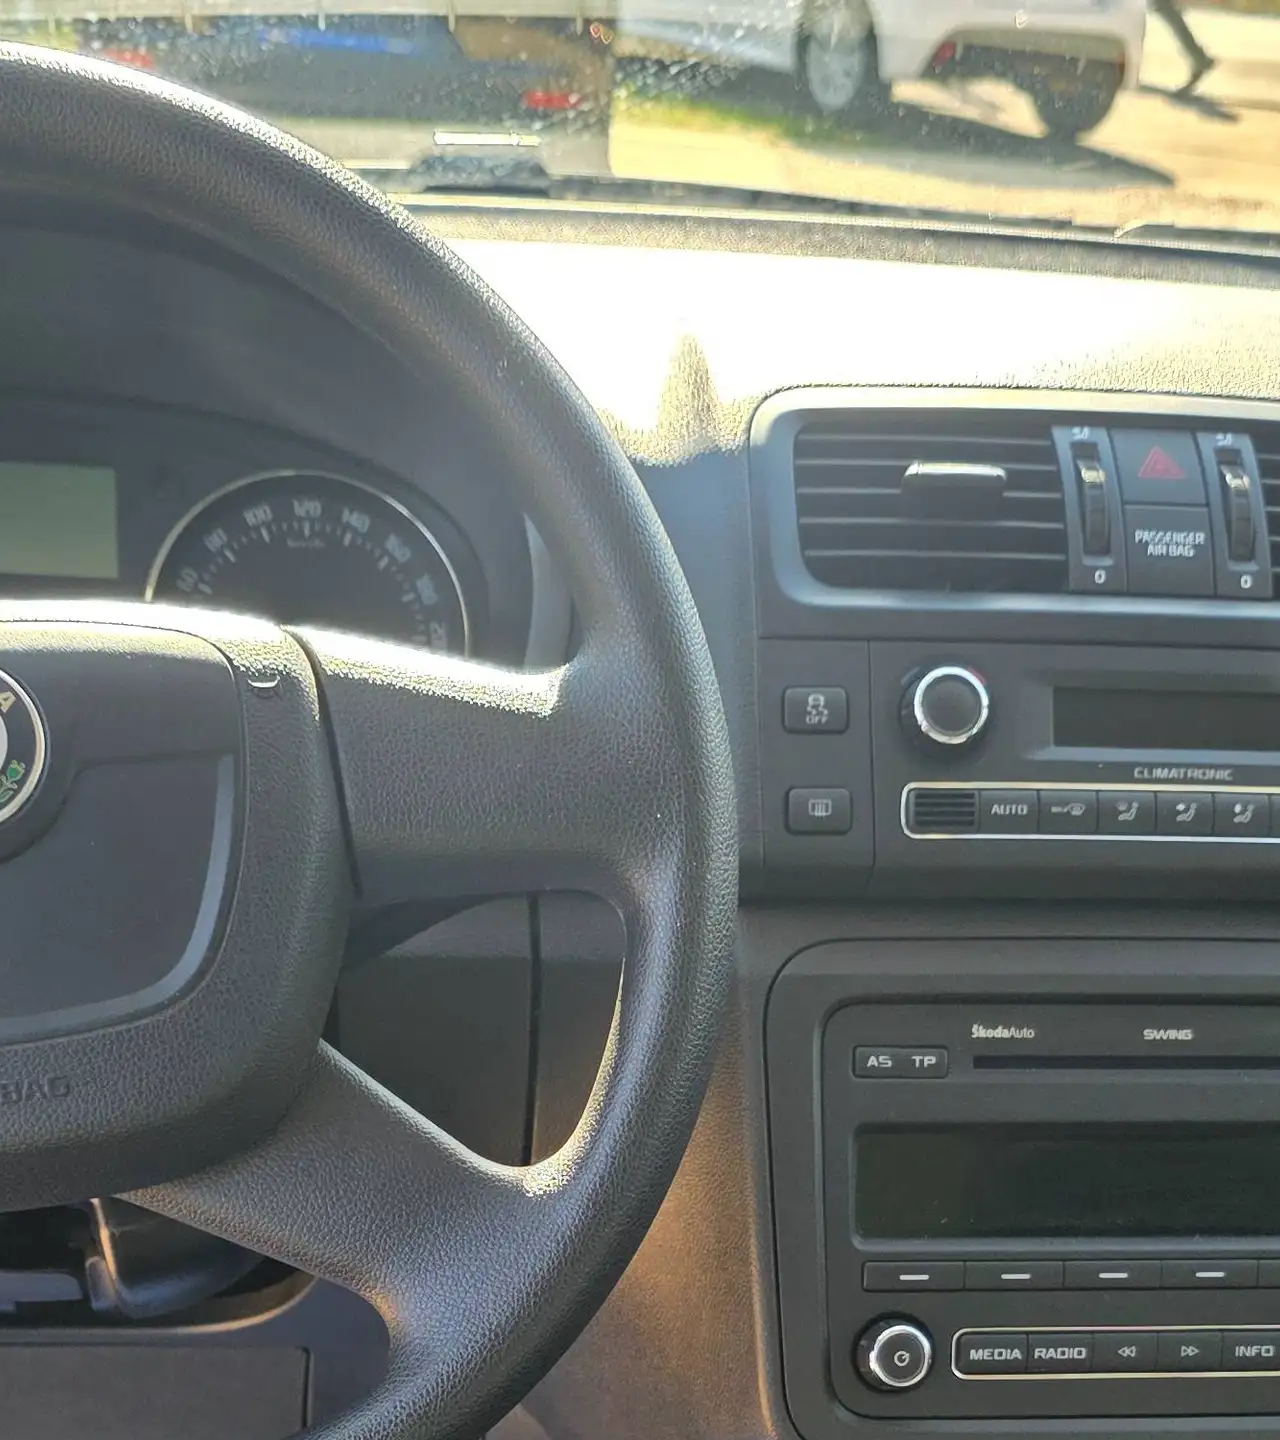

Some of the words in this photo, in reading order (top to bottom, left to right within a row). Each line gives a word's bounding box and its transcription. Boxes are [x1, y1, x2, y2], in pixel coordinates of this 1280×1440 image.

[1134, 529, 1206, 545] PASSENGER
[1133, 766, 1234, 781] CLIMATRONIC
[990, 803, 1029, 816] AUTO
[1143, 1028, 1194, 1041] SWING
[866, 1055, 893, 1068] AS
[911, 1055, 937, 1068] TP
[969, 1348, 1022, 1361] MEDIA
[1033, 1347, 1087, 1359] RADIO
[1234, 1345, 1275, 1357] INFO
